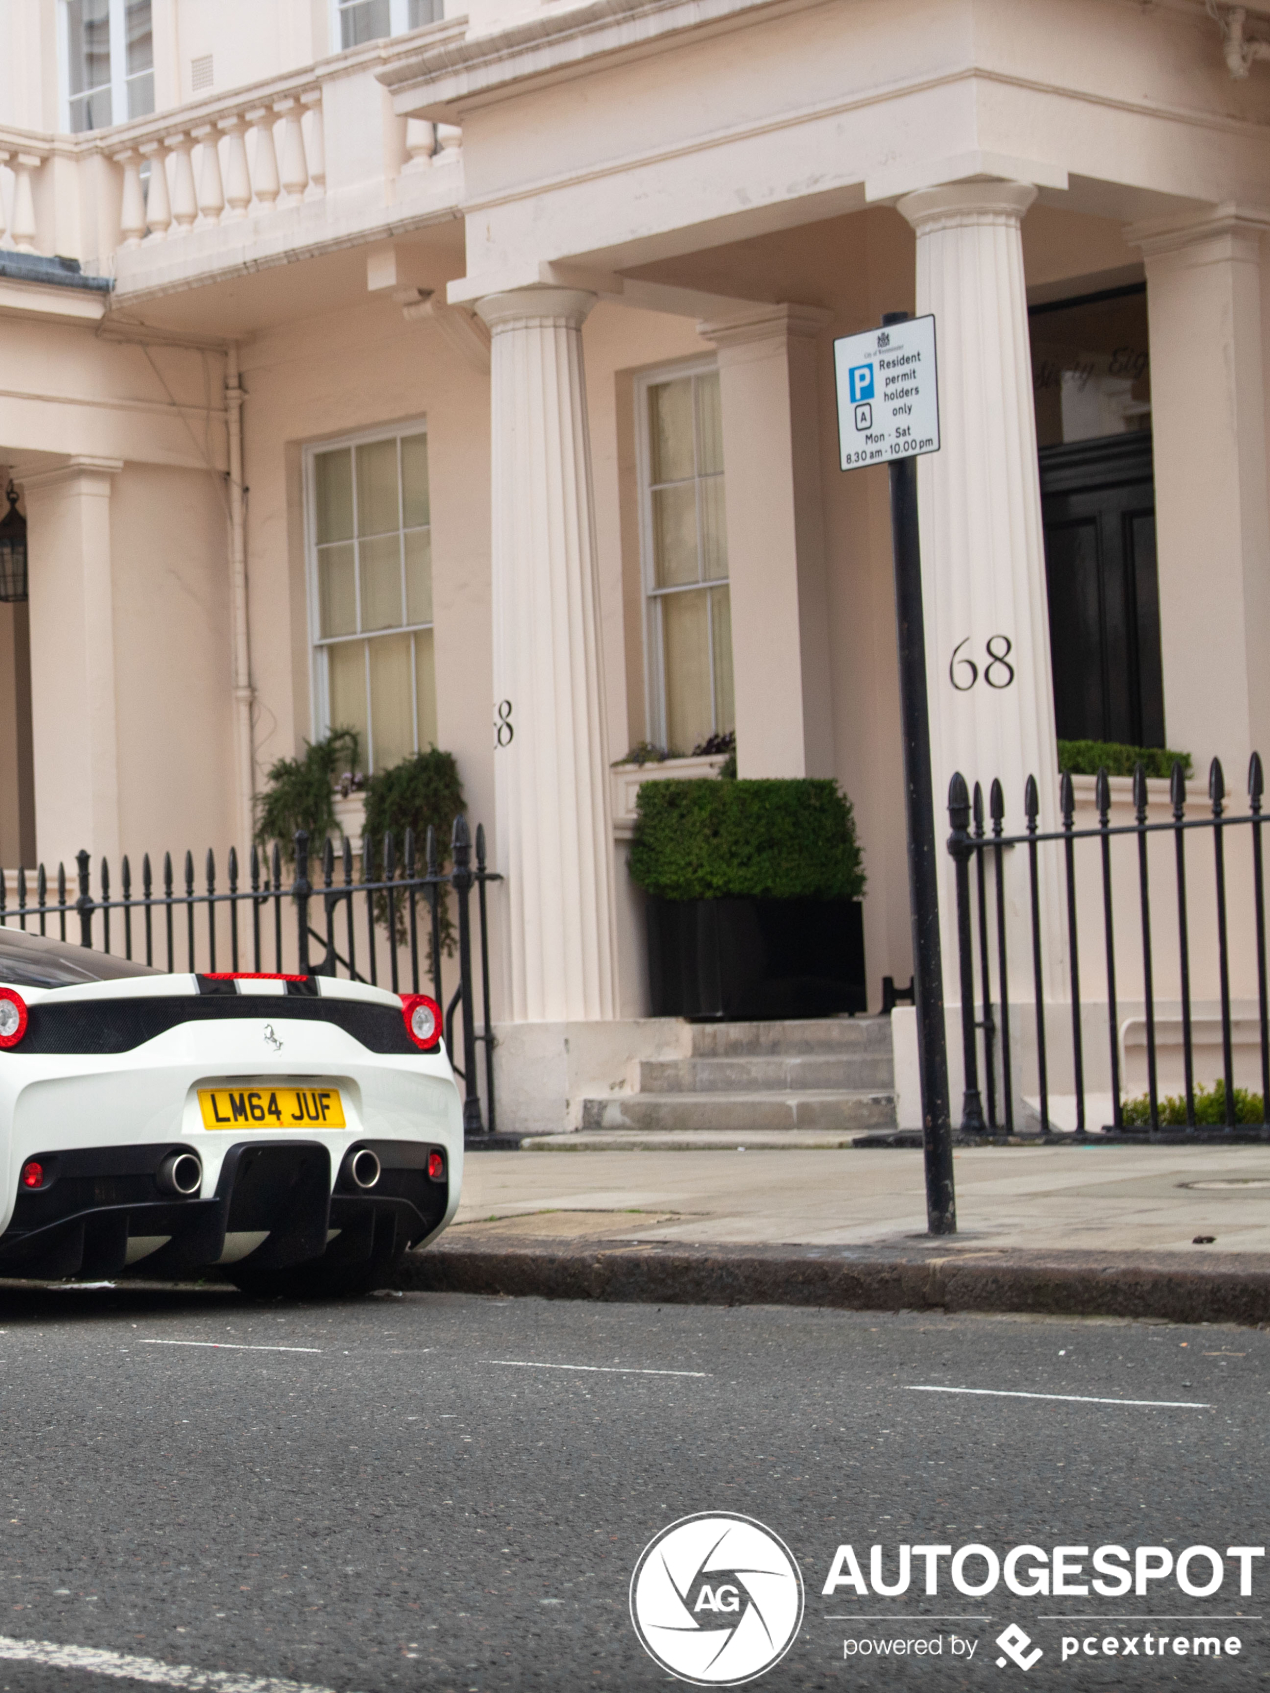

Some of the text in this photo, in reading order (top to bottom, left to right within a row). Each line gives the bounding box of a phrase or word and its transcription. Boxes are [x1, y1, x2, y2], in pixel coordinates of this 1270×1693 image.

[879, 351, 921, 370] Resident
[854, 367, 871, 400] P
[885, 368, 916, 388] permit
[884, 386, 919, 402] holders
[860, 411, 867, 423] A
[892, 402, 912, 416] only
[865, 432, 885, 445] Mon
[895, 425, 911, 438] Sat
[846, 450, 867, 465] 8.30
[870, 449, 883, 460] am
[890, 439, 917, 455] 10.00
[919, 438, 933, 451] pm
[949, 634, 1015, 692] 68
[493, 699, 514, 750] 8
[210, 1092, 331, 1123] LM64 JUF
